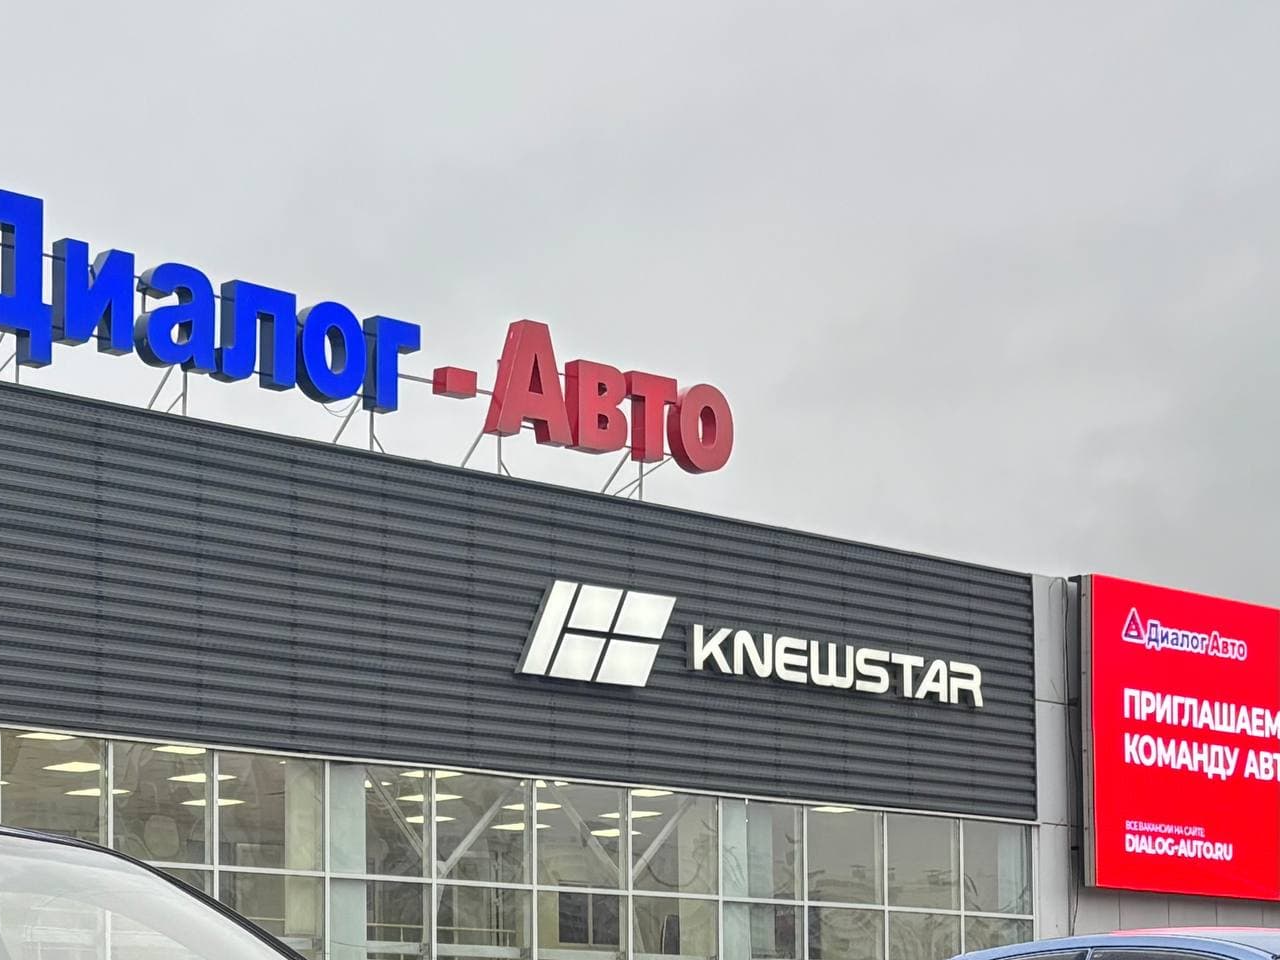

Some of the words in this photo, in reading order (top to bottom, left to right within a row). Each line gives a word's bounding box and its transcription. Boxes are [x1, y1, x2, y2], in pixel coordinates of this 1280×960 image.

[692, 623, 984, 707] KNEWSTAR
[1123, 687, 1280, 739] ПРИГЛАШАЕМ
[1123, 732, 1240, 781] КОМАНДУ
[1125, 833, 1233, 861] DIALOG-AUTO.RU
